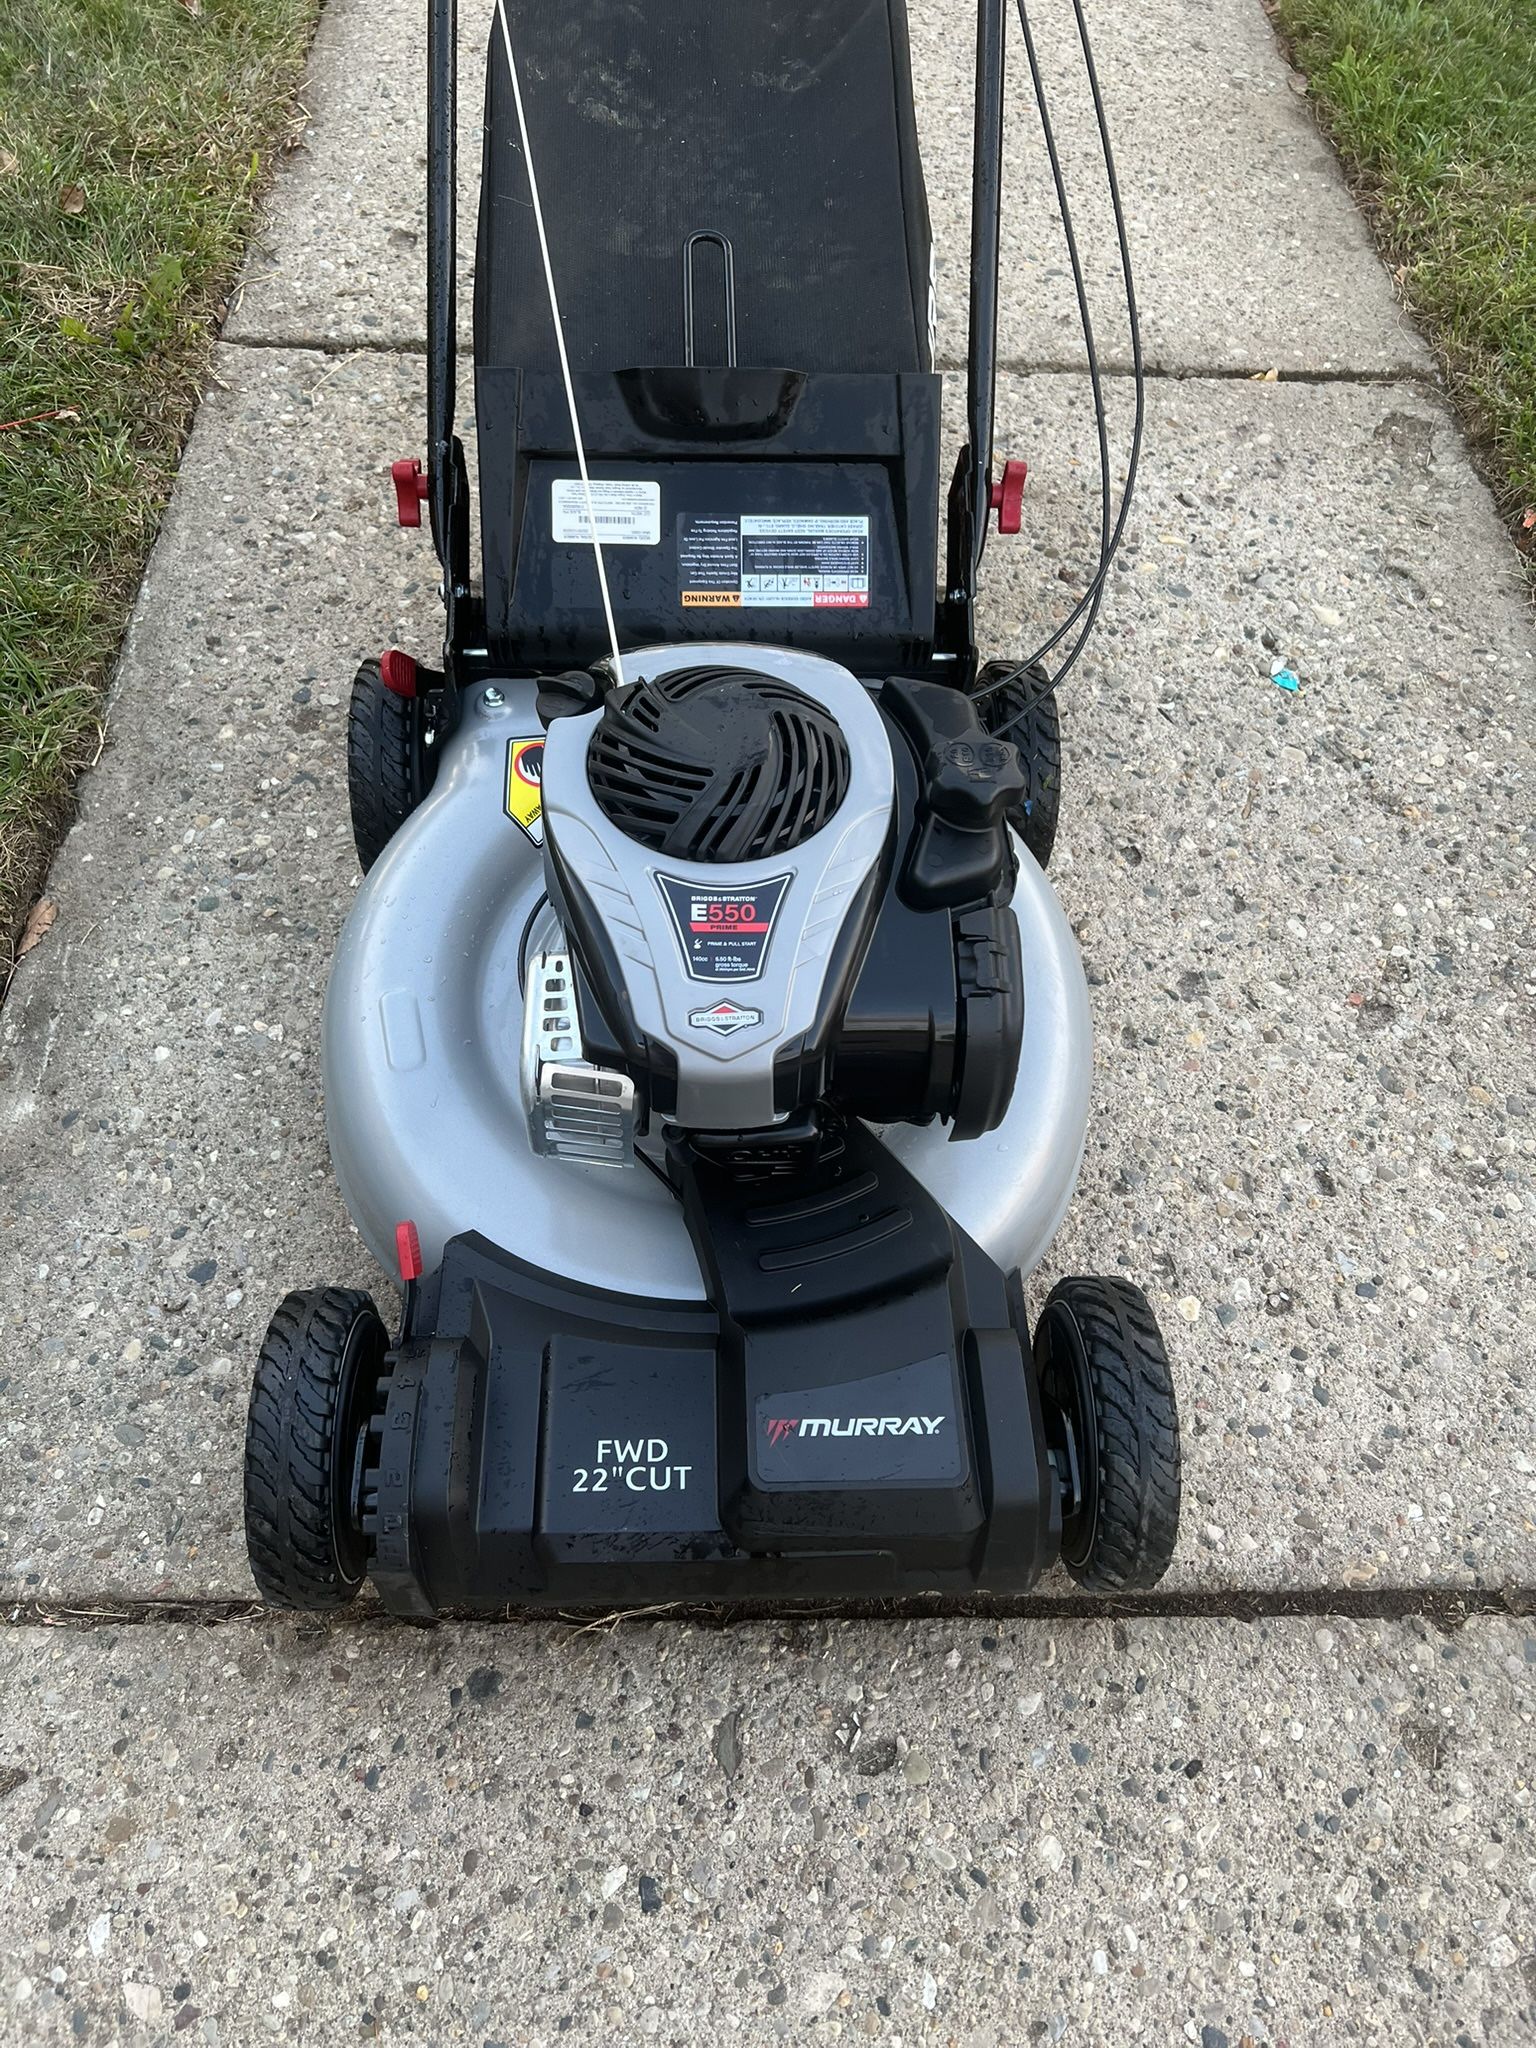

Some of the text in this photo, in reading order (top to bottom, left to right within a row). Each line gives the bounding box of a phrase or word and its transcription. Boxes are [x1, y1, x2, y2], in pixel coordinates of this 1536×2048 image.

[815, 595, 856, 603] DANGER
[691, 903, 756, 922] E550
[799, 1416, 945, 1437] MURRAY
[597, 1438, 669, 1463] FWD
